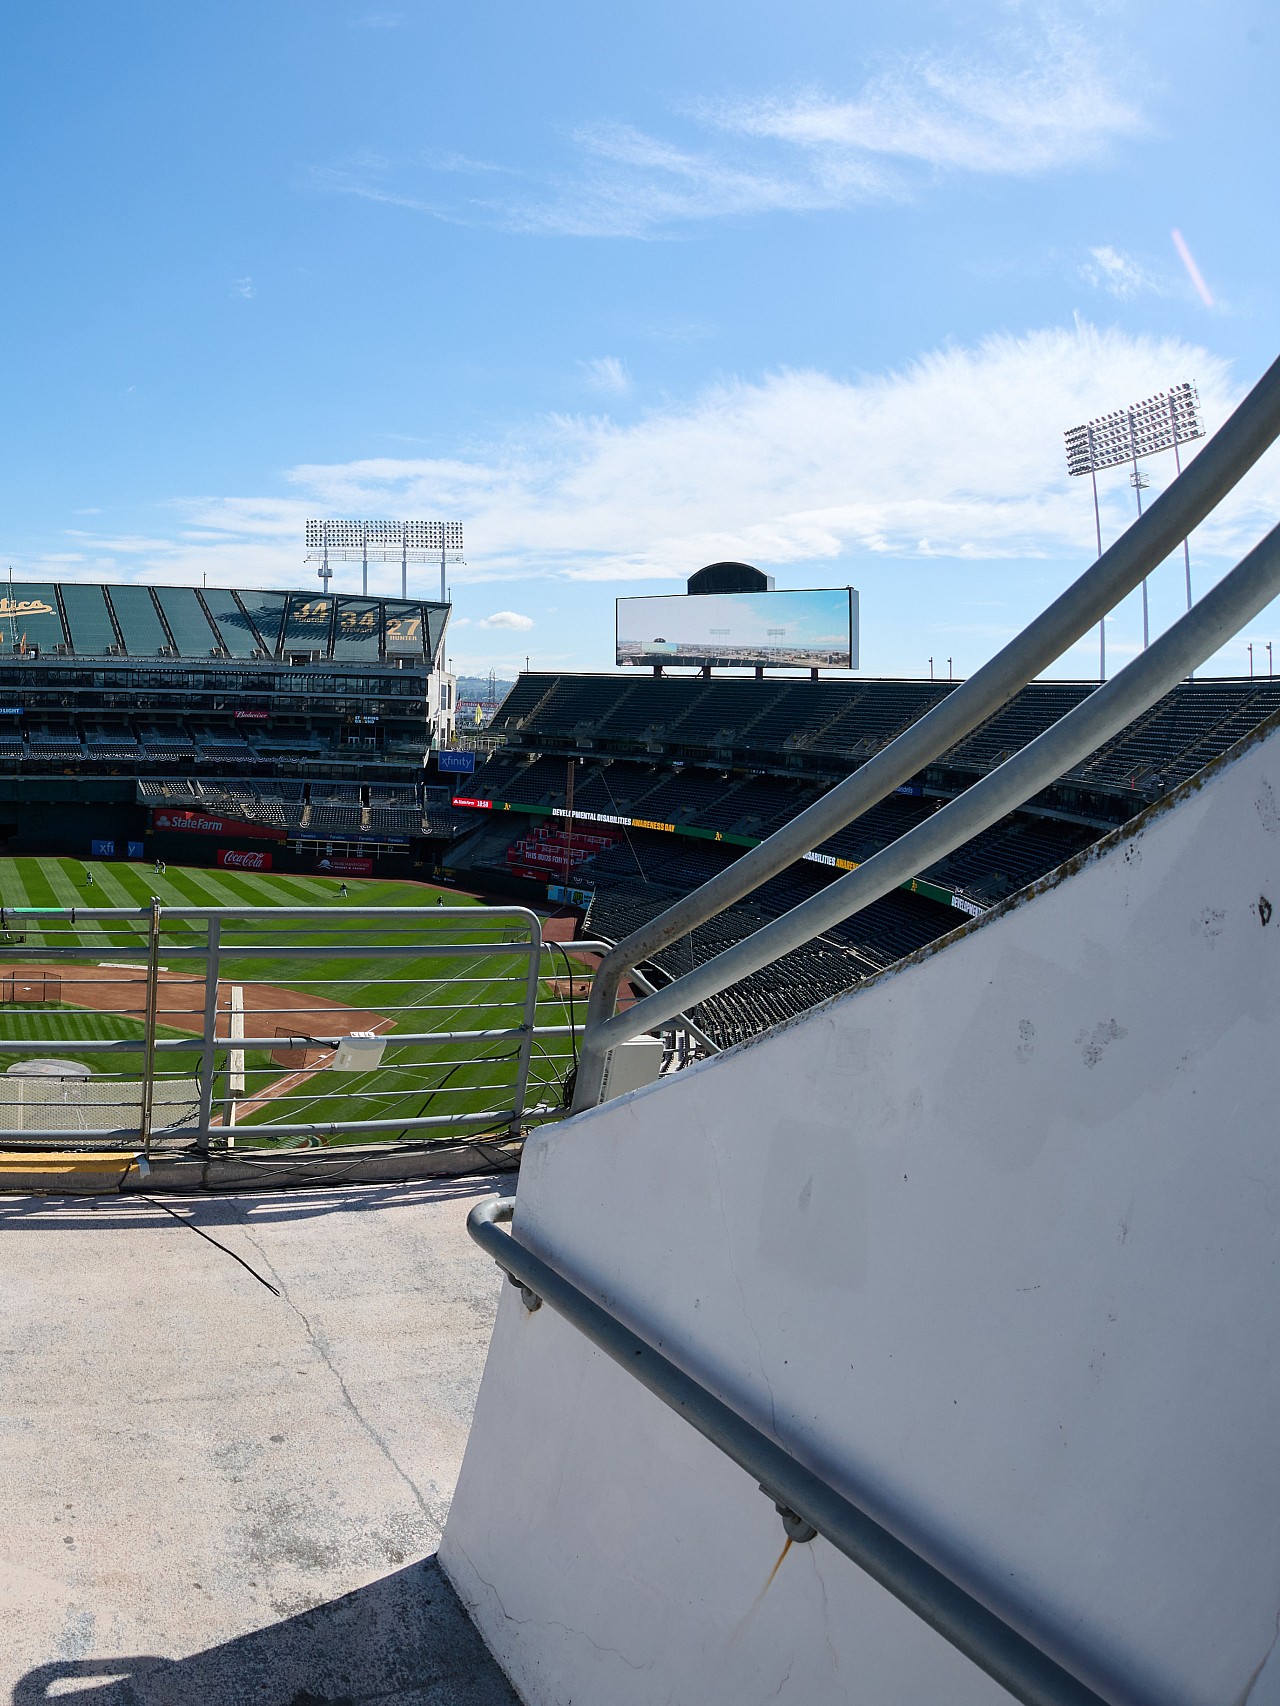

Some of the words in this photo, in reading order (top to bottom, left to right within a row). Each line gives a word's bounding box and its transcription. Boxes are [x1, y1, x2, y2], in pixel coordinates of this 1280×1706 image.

[293, 602, 329, 617] 34
[340, 611, 376, 628] 34
[386, 619, 421, 636] 27
[441, 755, 472, 768] xfinity
[597, 814, 632, 826] DISABILITIES
[632, 819, 665, 831] AWARENESS
[664, 824, 675, 833] DAY
[525, 851, 537, 860] THIS
[552, 856, 563, 864] FOR
